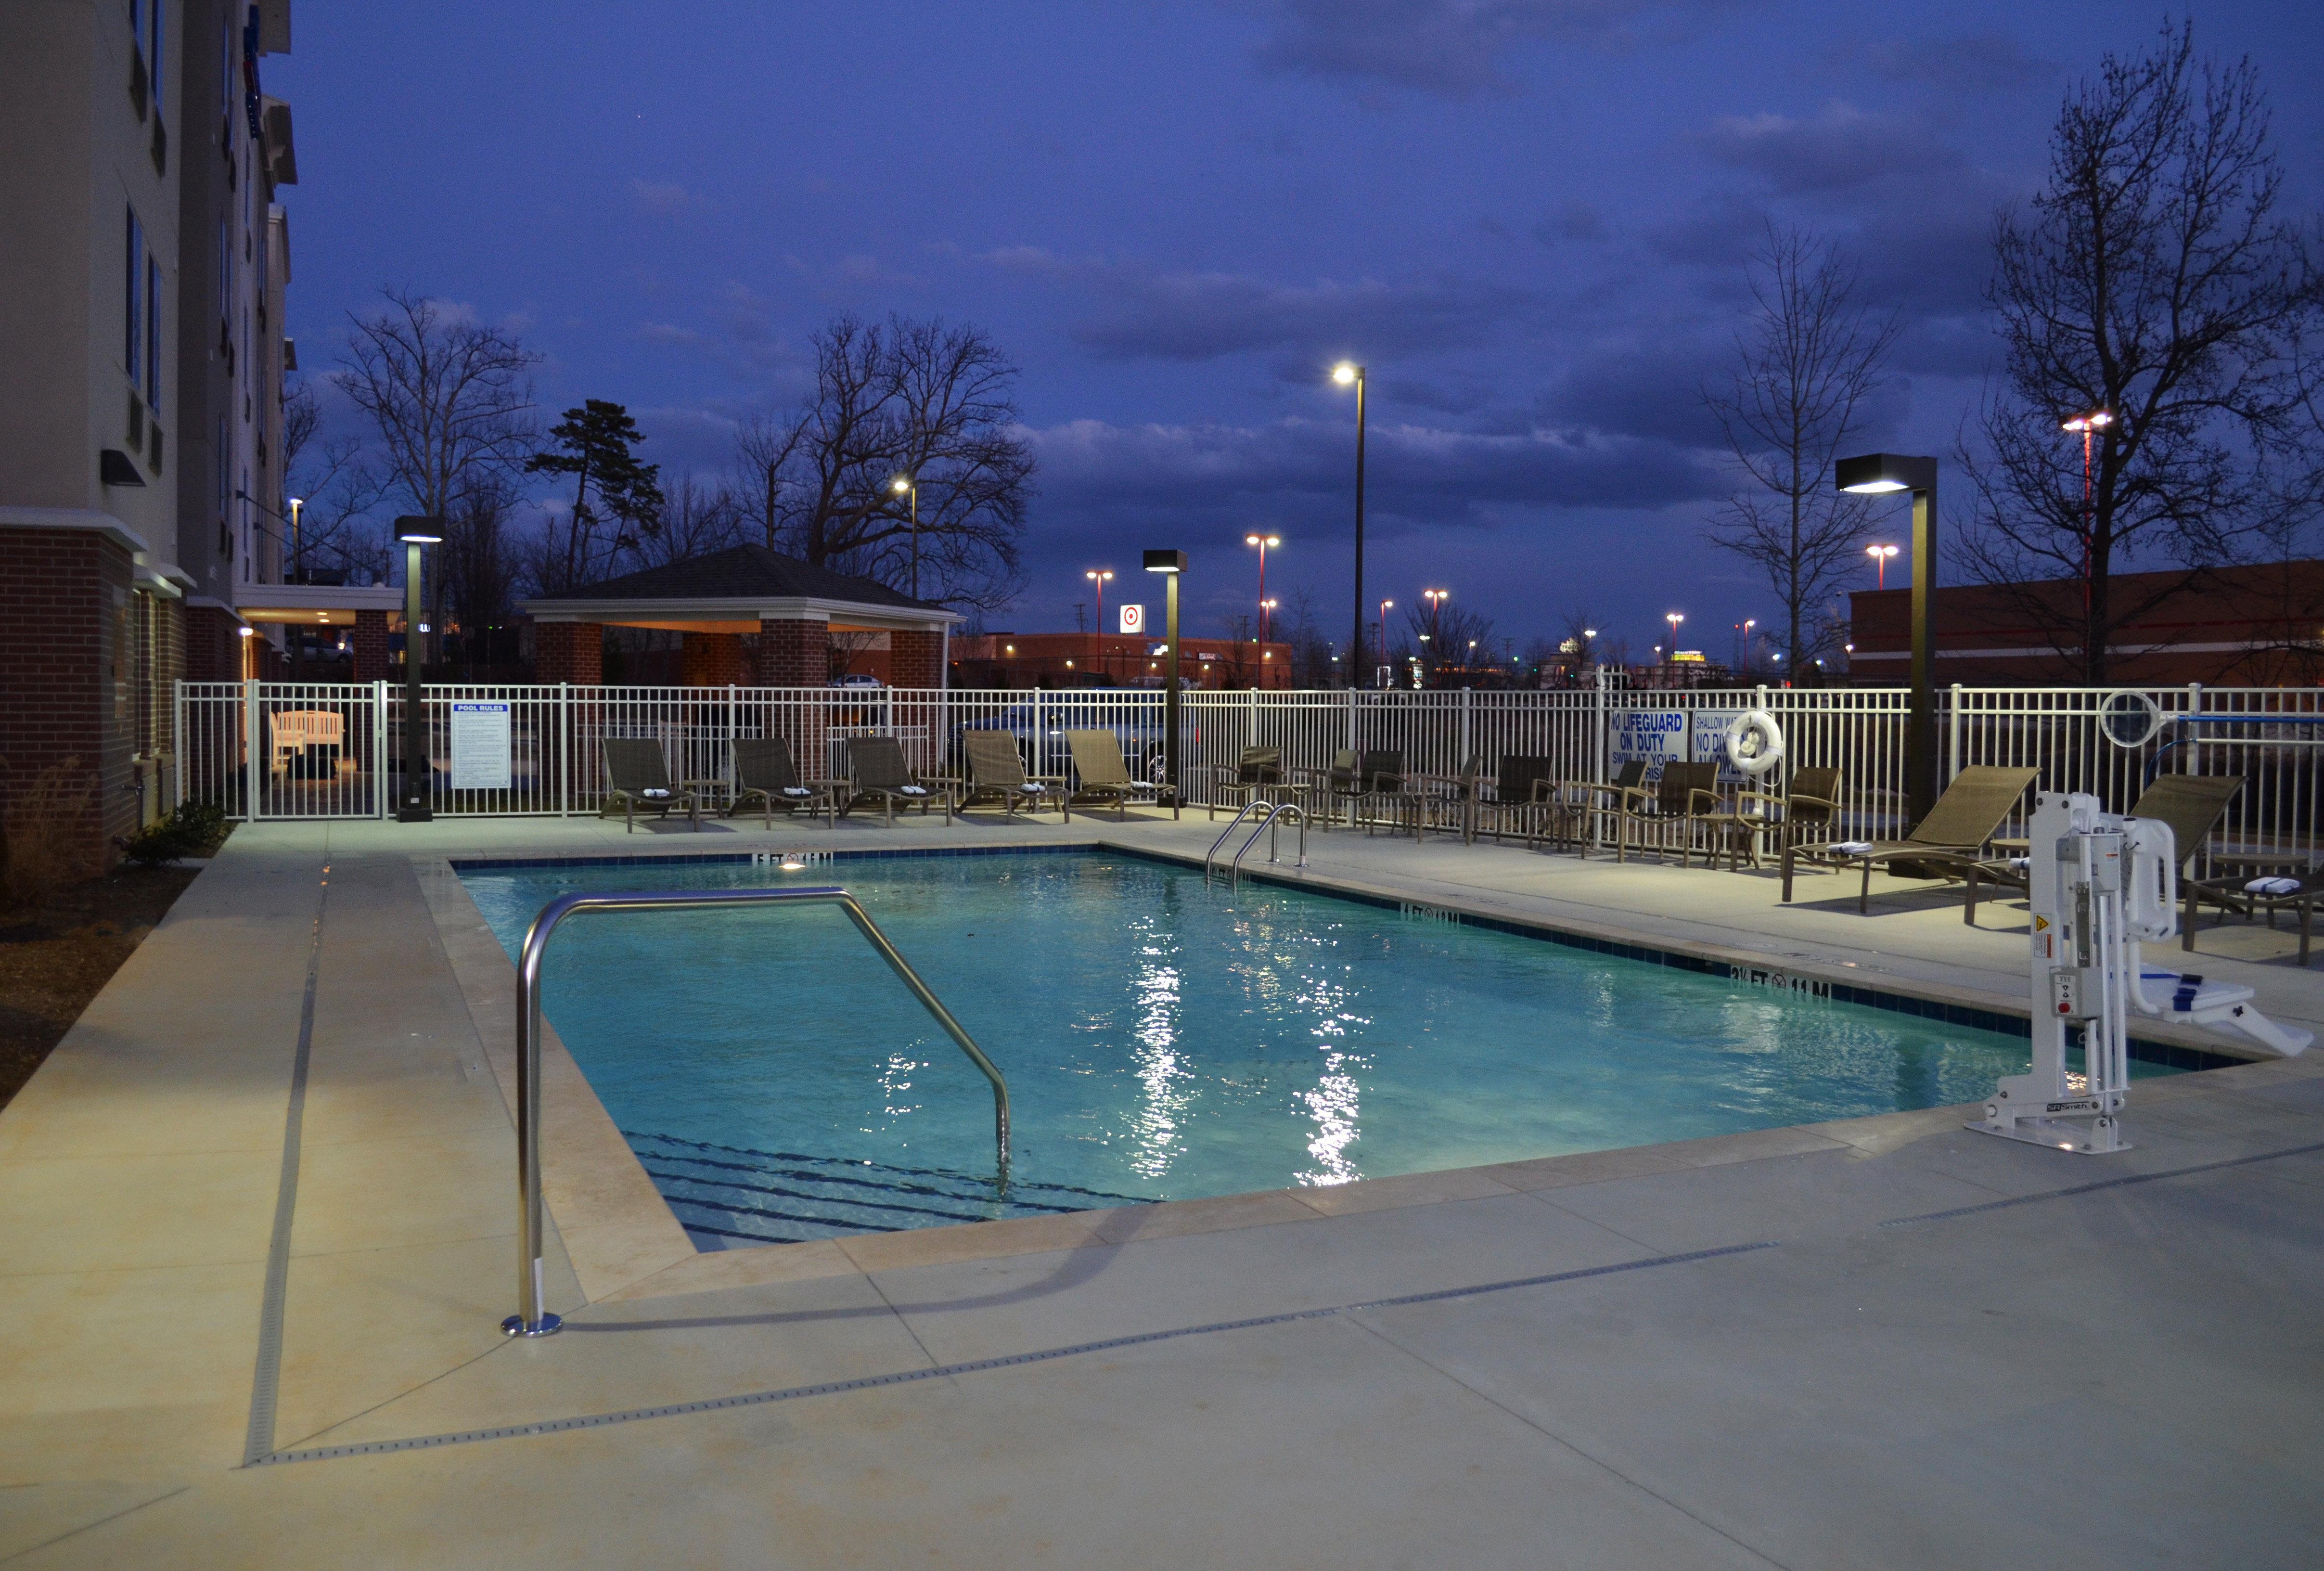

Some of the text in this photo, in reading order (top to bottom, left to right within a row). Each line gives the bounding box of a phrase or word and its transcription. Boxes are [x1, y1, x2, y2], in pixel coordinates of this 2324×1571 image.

[1611, 713, 1682, 732] NO LIFEGUARD
[1696, 717, 1723, 729] SHALLOW
[1620, 732, 1665, 751] ON DUTY
[1696, 733, 1709, 752] NO
[1636, 753, 1646, 762] AT
[1751, 969, 1768, 984] FT
[1812, 981, 1828, 998] M
